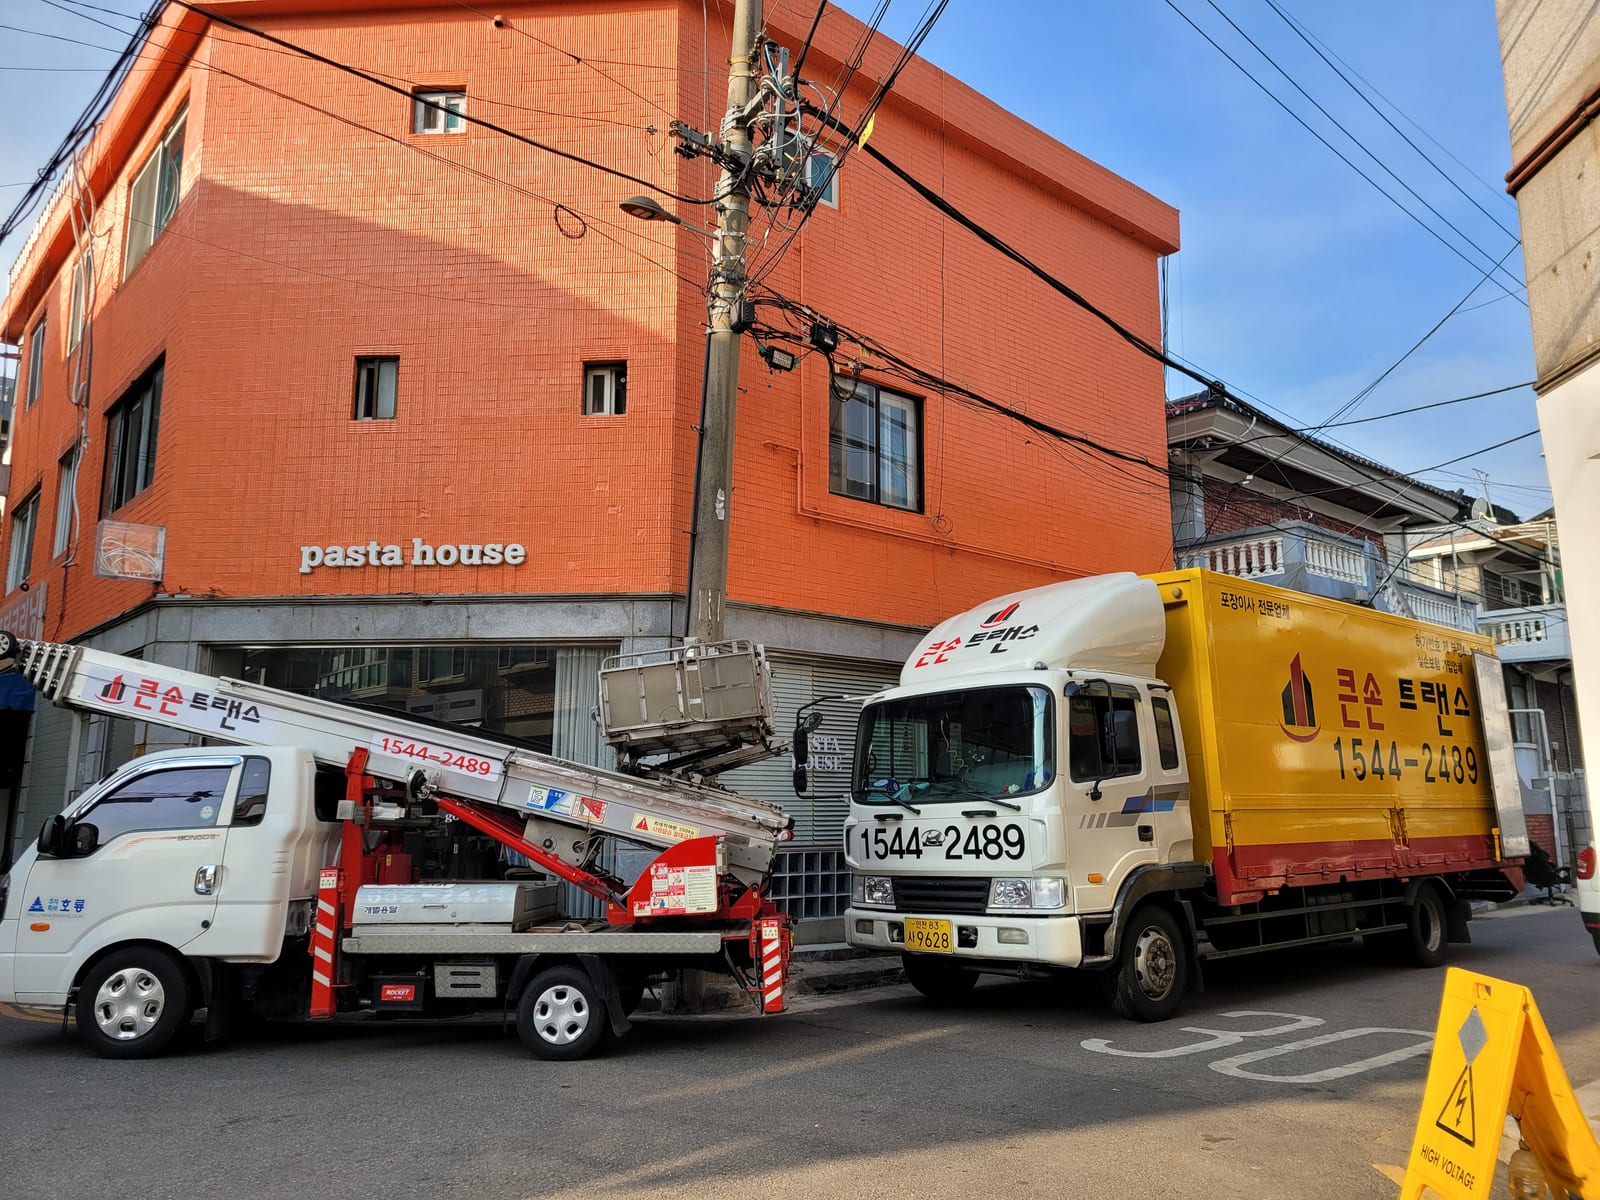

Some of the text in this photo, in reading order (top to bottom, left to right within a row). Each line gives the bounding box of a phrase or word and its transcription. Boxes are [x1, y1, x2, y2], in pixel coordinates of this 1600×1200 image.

[299, 537, 527, 573] pasta house
[1220, 591, 1291, 620] 포장이사 전문업체
[914, 624, 1040, 668] 큰손 트랜스
[133, 678, 260, 731] 큰손 트랜스
[1336, 668, 1471, 736] 큰손 트랜스
[382, 737, 491, 776] 1544-2489
[1333, 735, 1478, 785] 1544-2489
[363, 906, 398, 915] 개별용달
[915, 920, 940, 930] 인천 83
[1080, 1011, 1434, 1083] 30
[1420, 1143, 1476, 1191] HIGH VOLTAGE
